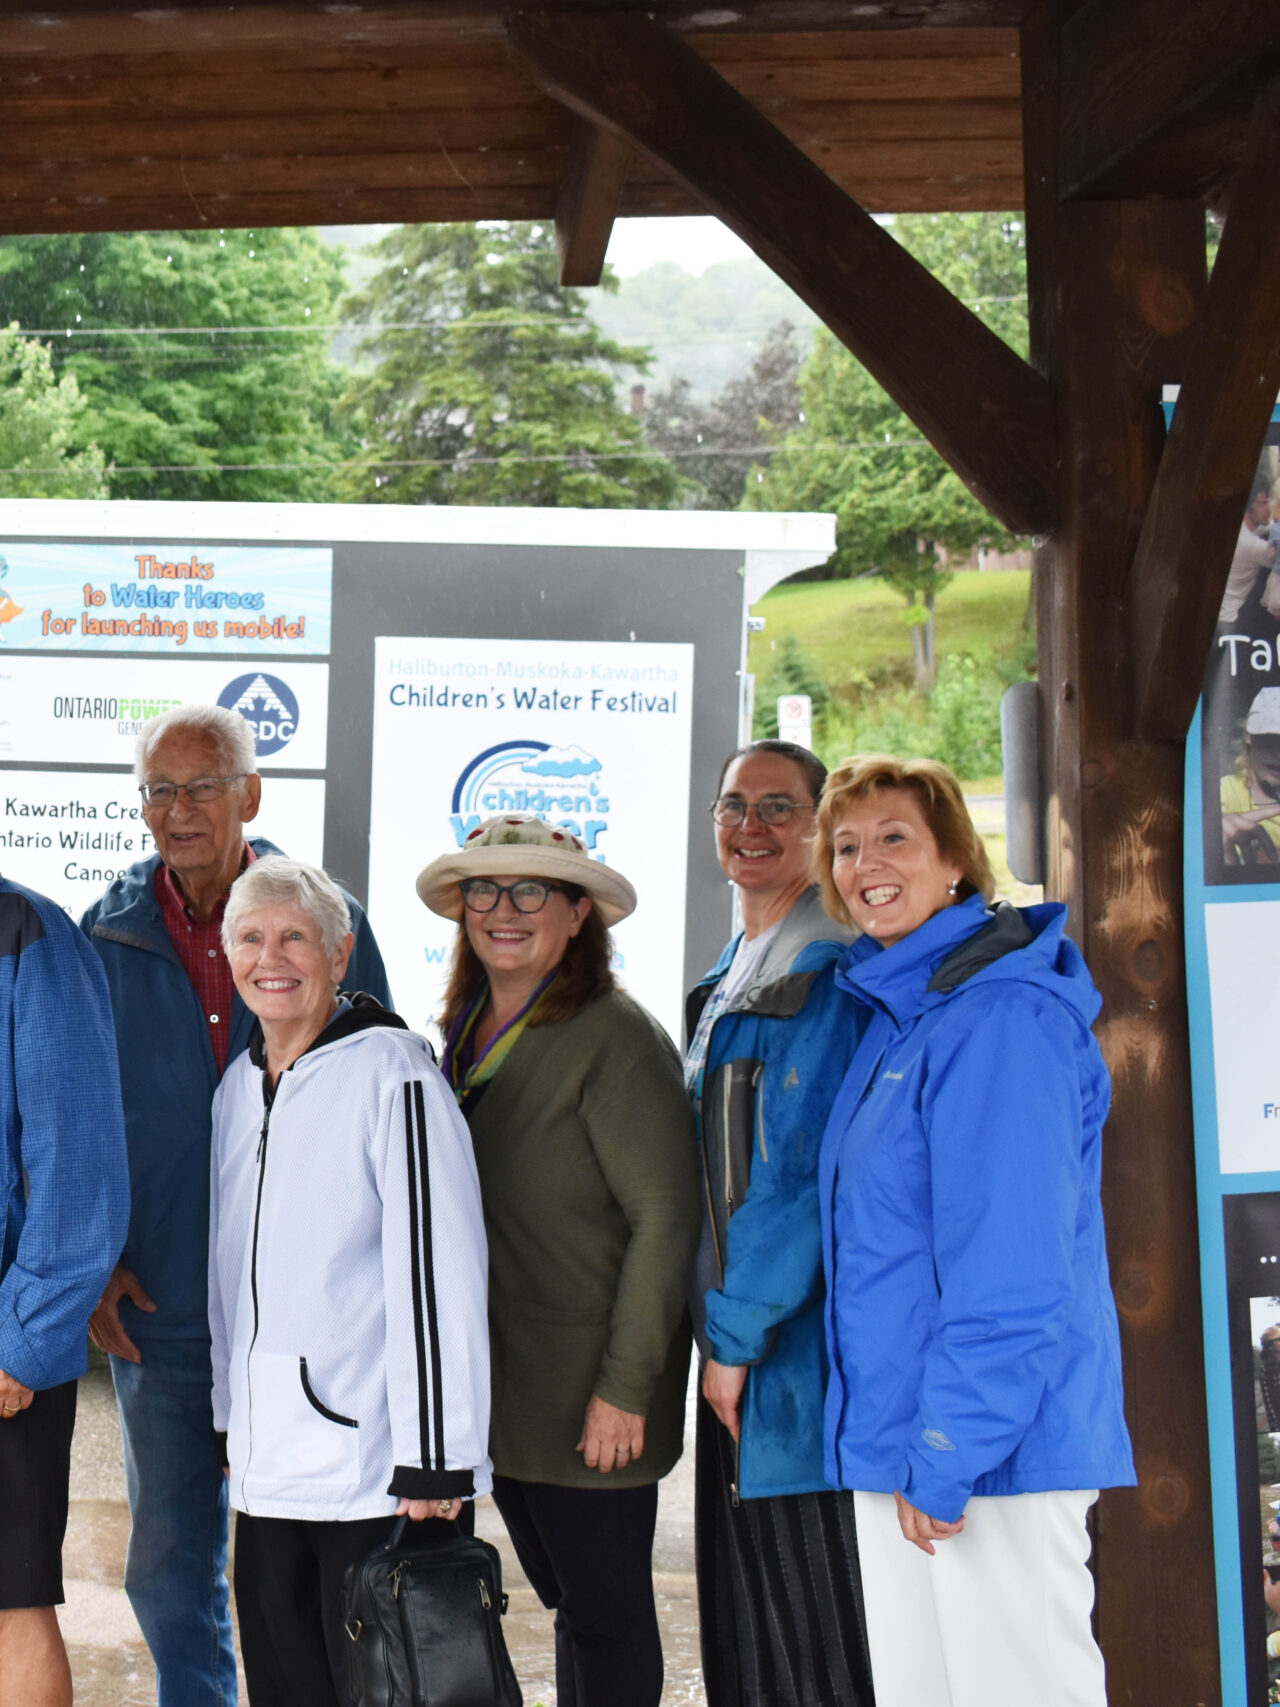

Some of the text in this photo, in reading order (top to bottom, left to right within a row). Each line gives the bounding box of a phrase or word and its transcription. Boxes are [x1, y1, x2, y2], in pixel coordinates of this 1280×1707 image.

[135, 555, 214, 580] Thanks
[83, 583, 265, 610] to Water Heroes
[42, 610, 306, 646] for launching us mobile!
[389, 659, 679, 682] Haliburton-Muskoka-Kawartha
[390, 684, 677, 713] Children's Water Festival
[5, 798, 97, 819] Kawartha
[59, 831, 134, 852] Wildlife
[64, 862, 127, 881] Canoe
